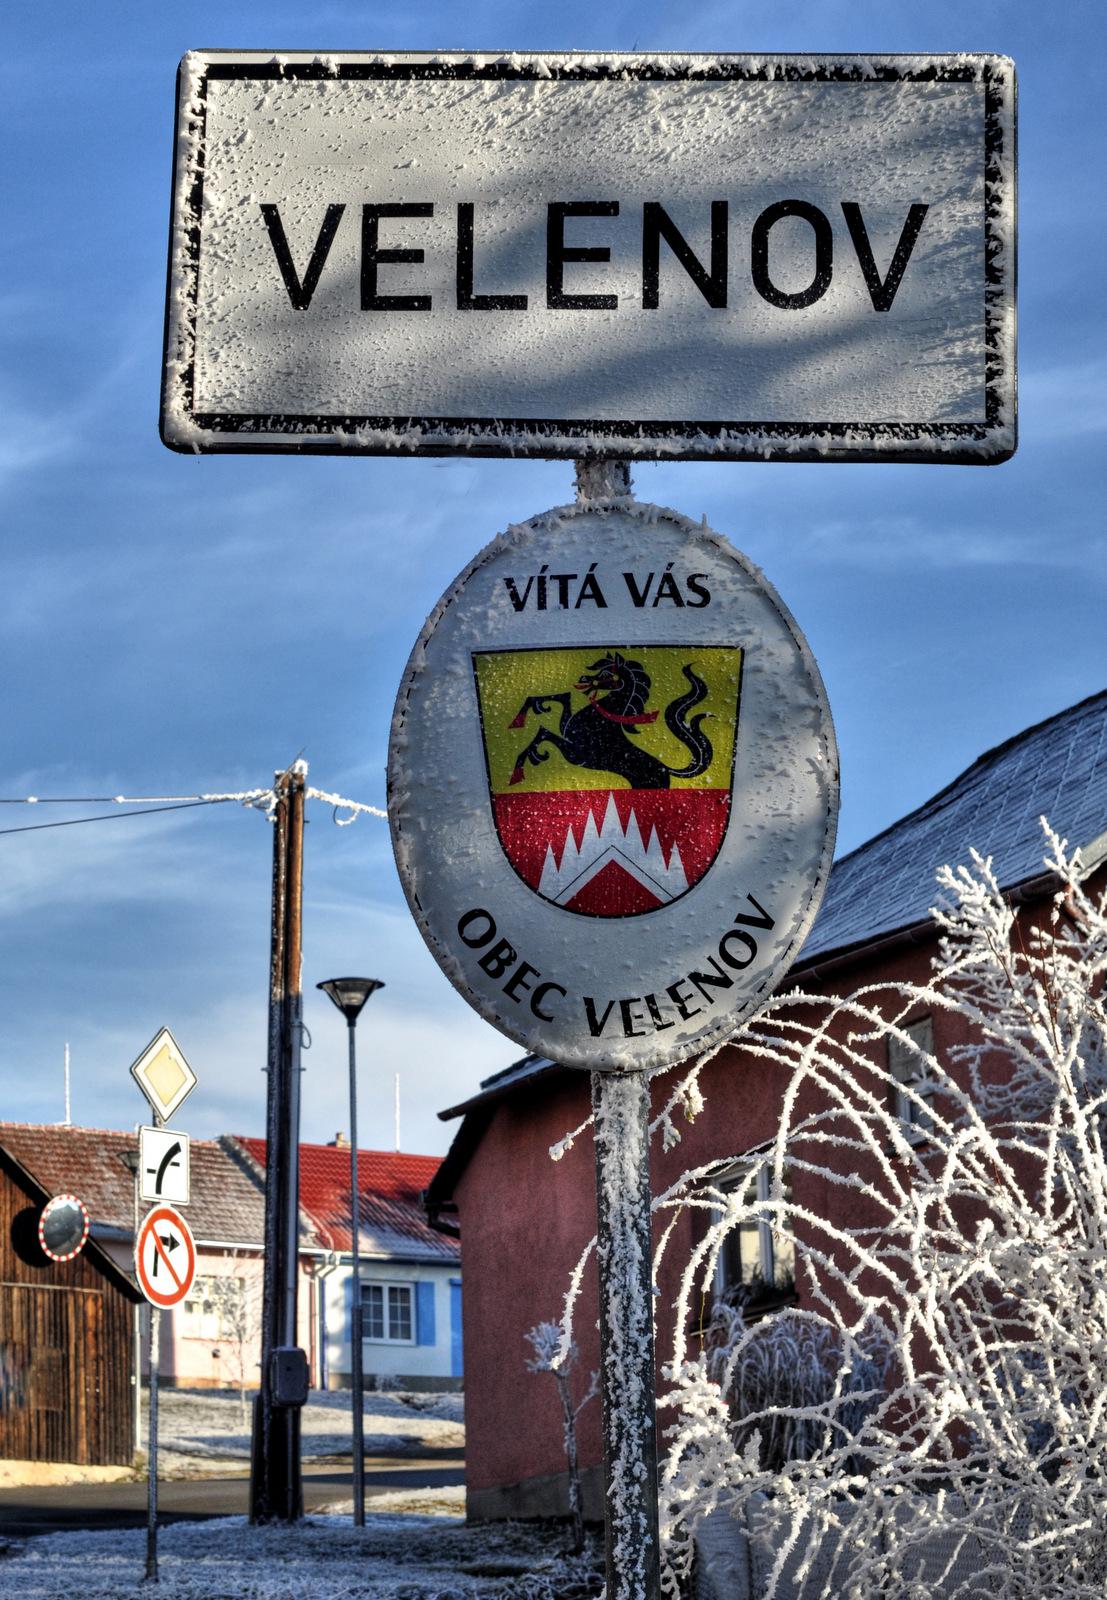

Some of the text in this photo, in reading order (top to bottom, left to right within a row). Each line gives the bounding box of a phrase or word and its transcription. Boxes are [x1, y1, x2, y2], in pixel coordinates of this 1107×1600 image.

[259, 200, 929, 312] VELENOV
[503, 562, 711, 612] VÍTÁ VÁS
[457, 892, 776, 1038] OBEC VELENOV
